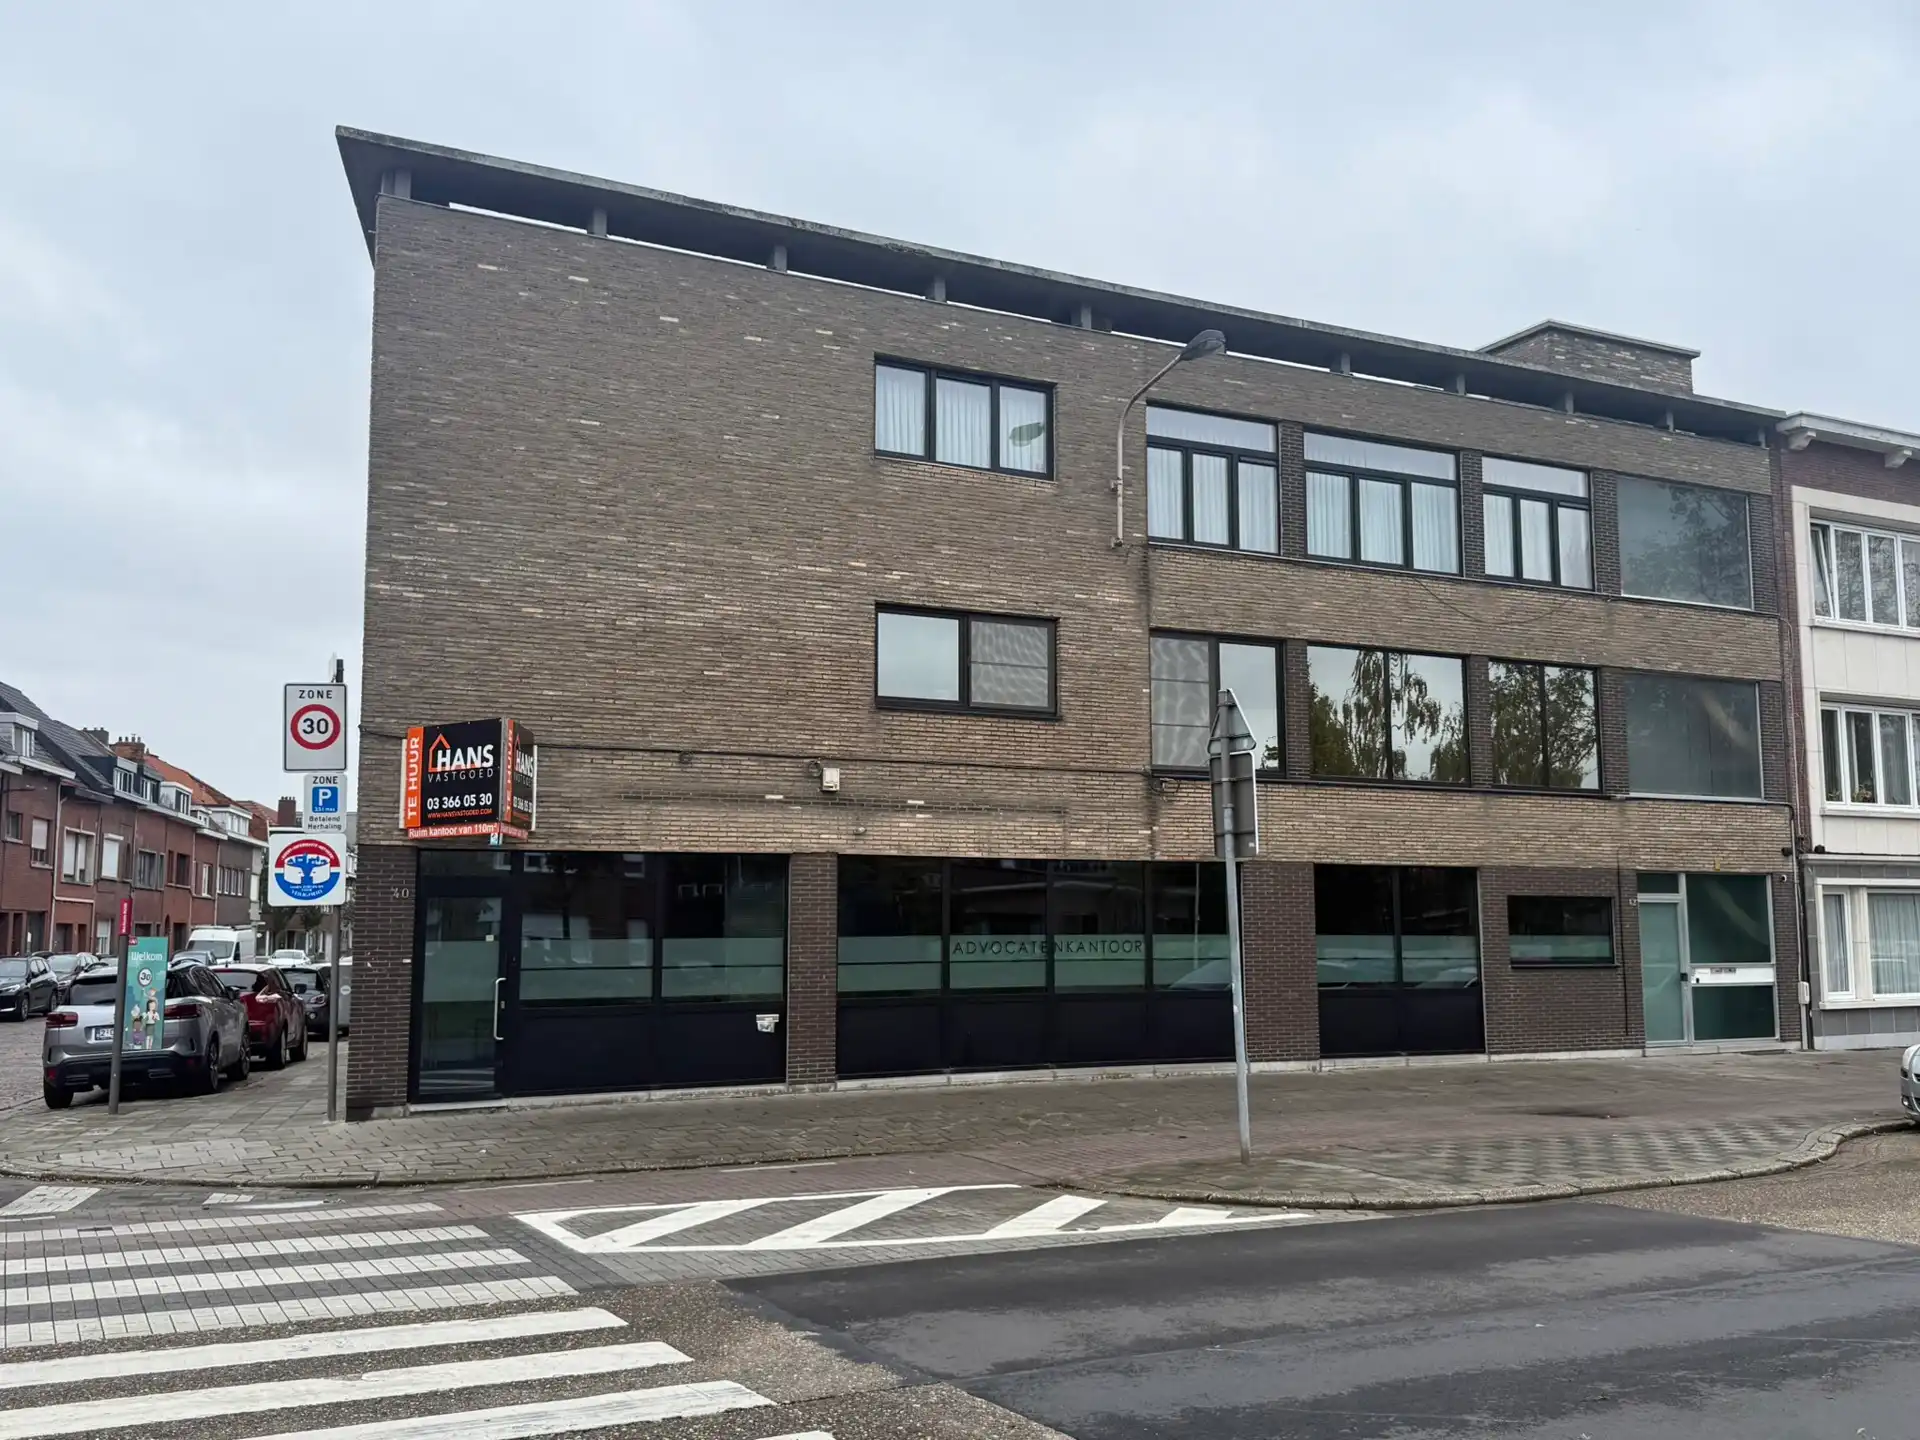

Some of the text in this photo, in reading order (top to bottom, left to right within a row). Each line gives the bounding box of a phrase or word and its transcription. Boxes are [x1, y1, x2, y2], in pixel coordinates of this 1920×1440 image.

[298, 689, 333, 699] ZONE
[302, 717, 329, 735] 30
[436, 744, 494, 772] HANS
[312, 776, 338, 785] ZONE
[407, 737, 420, 819] TE HUUR
[427, 768, 494, 783] VASTGOED
[427, 793, 493, 810] 03 366 05 30
[307, 823, 342, 831] Herhaling
[409, 828, 428, 839] Ruim
[429, 826, 458, 837] kantoor
[459, 825, 473, 834] van
[952, 939, 1143, 957] ADVOCATENKANTOOR
[131, 951, 163, 961] Welkom
[140, 972, 151, 981] 30
